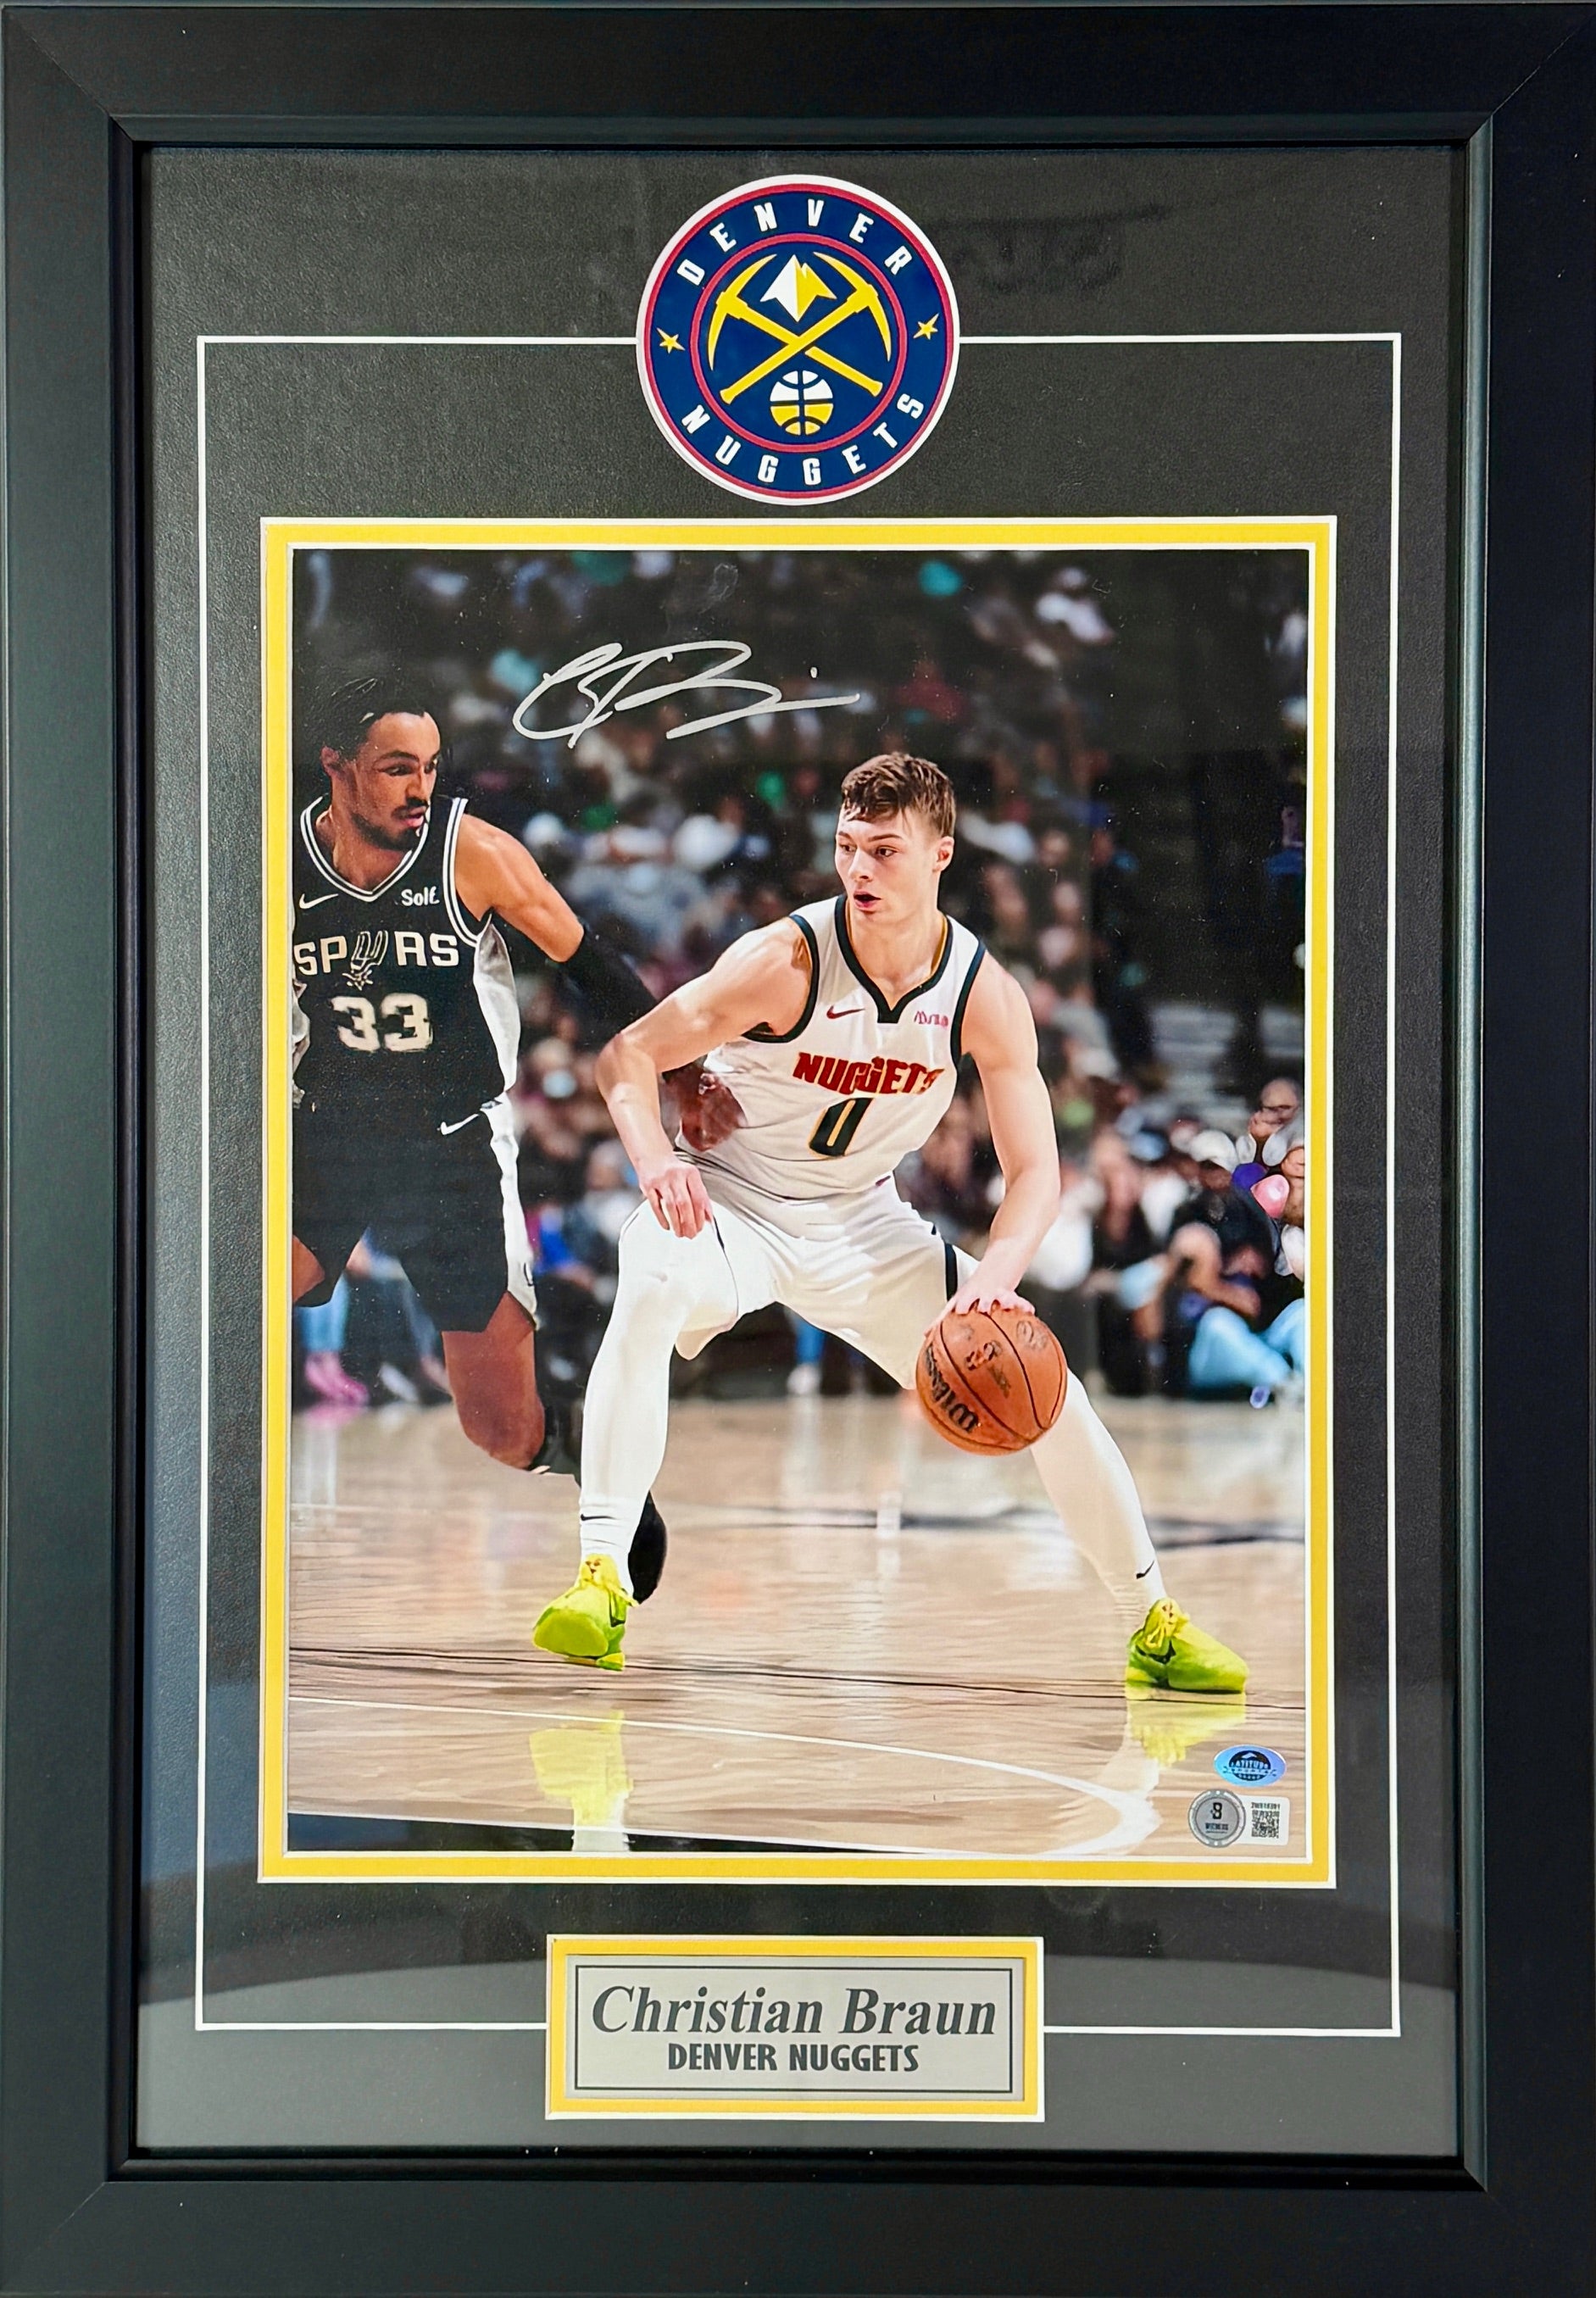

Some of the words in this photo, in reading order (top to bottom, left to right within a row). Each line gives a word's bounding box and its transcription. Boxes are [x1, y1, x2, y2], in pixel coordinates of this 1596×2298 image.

[677, 199, 913, 286] DENVER
[681, 393, 925, 486] NUGGETS
[331, 993, 433, 1053] 33
[809, 1097, 874, 1157] 0
[592, 1985, 821, 2034] Christian
[838, 1988, 996, 2035] Braun
[668, 2043, 777, 2071] DENVER
[789, 2044, 920, 2072] NUGGETS
